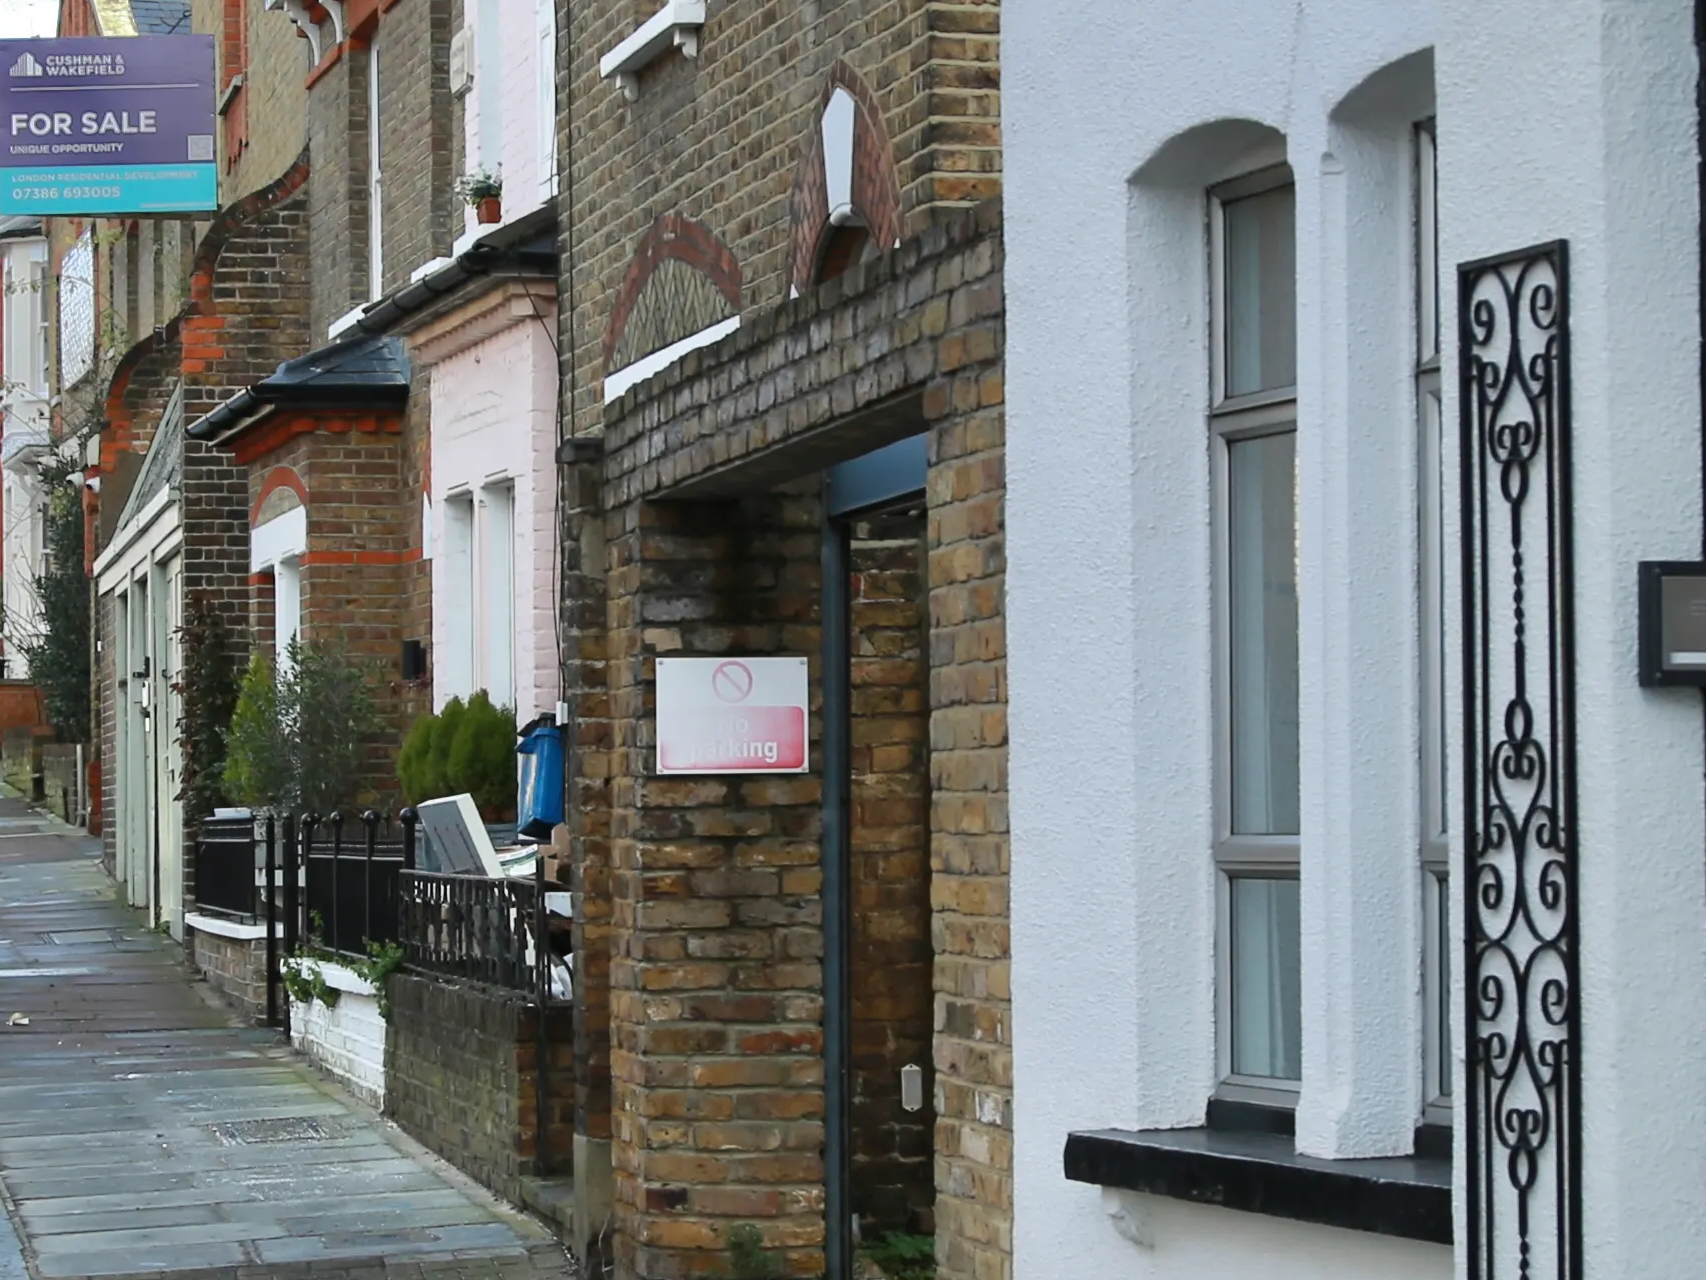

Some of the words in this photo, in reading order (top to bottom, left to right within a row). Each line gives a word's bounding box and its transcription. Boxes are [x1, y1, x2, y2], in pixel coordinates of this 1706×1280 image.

[46, 54, 111, 66] CUSHMAN
[115, 54, 124, 65] &
[46, 65, 126, 76] WAKEFIELD
[10, 112, 72, 136] FOR
[81, 110, 157, 135] SALE
[10, 144, 50, 155] UNIQUE
[51, 142, 124, 154] OPPORTUNITY
[11, 173, 55, 183] LONDON
[57, 172, 122, 182] RESIDENTIAL
[124, 170, 198, 181] DEVELOPMENT
[12, 187, 59, 200] 07386
[63, 186, 121, 199] 693005
[718, 714, 749, 733] No
[689, 737, 778, 763] parking
